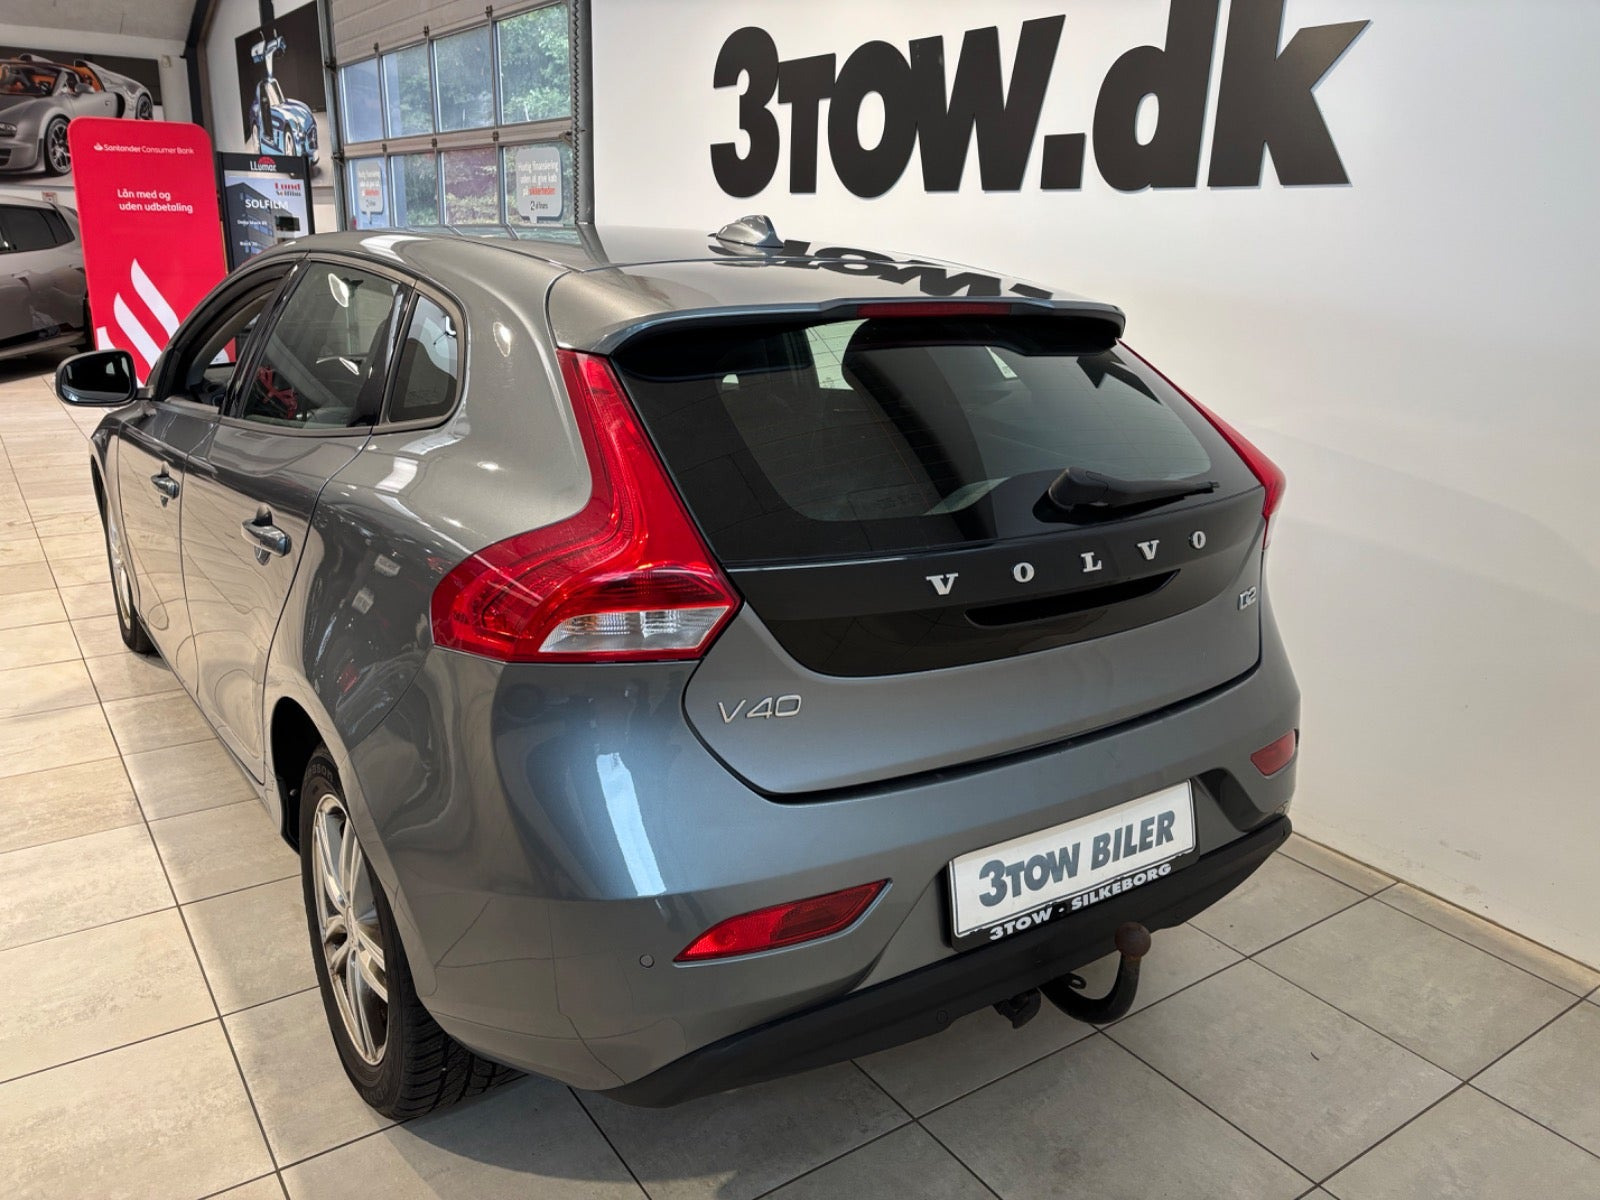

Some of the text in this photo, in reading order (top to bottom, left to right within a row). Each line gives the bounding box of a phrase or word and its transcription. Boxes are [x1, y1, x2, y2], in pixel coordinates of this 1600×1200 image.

[710, 0, 1371, 199] 3TOW.dk
[103, 144, 195, 155] Santander Consumer Bank
[117, 188, 171, 202] Lån med og
[119, 202, 193, 214] uden udbetaling
[245, 199, 289, 210] SOLFILM
[926, 531, 1207, 596] VOLVO
[718, 694, 802, 724] V40
[978, 809, 1176, 908] 3TOW BILER
[989, 906, 1053, 941] 3TOW
[1071, 863, 1172, 911] SILKEBORG
